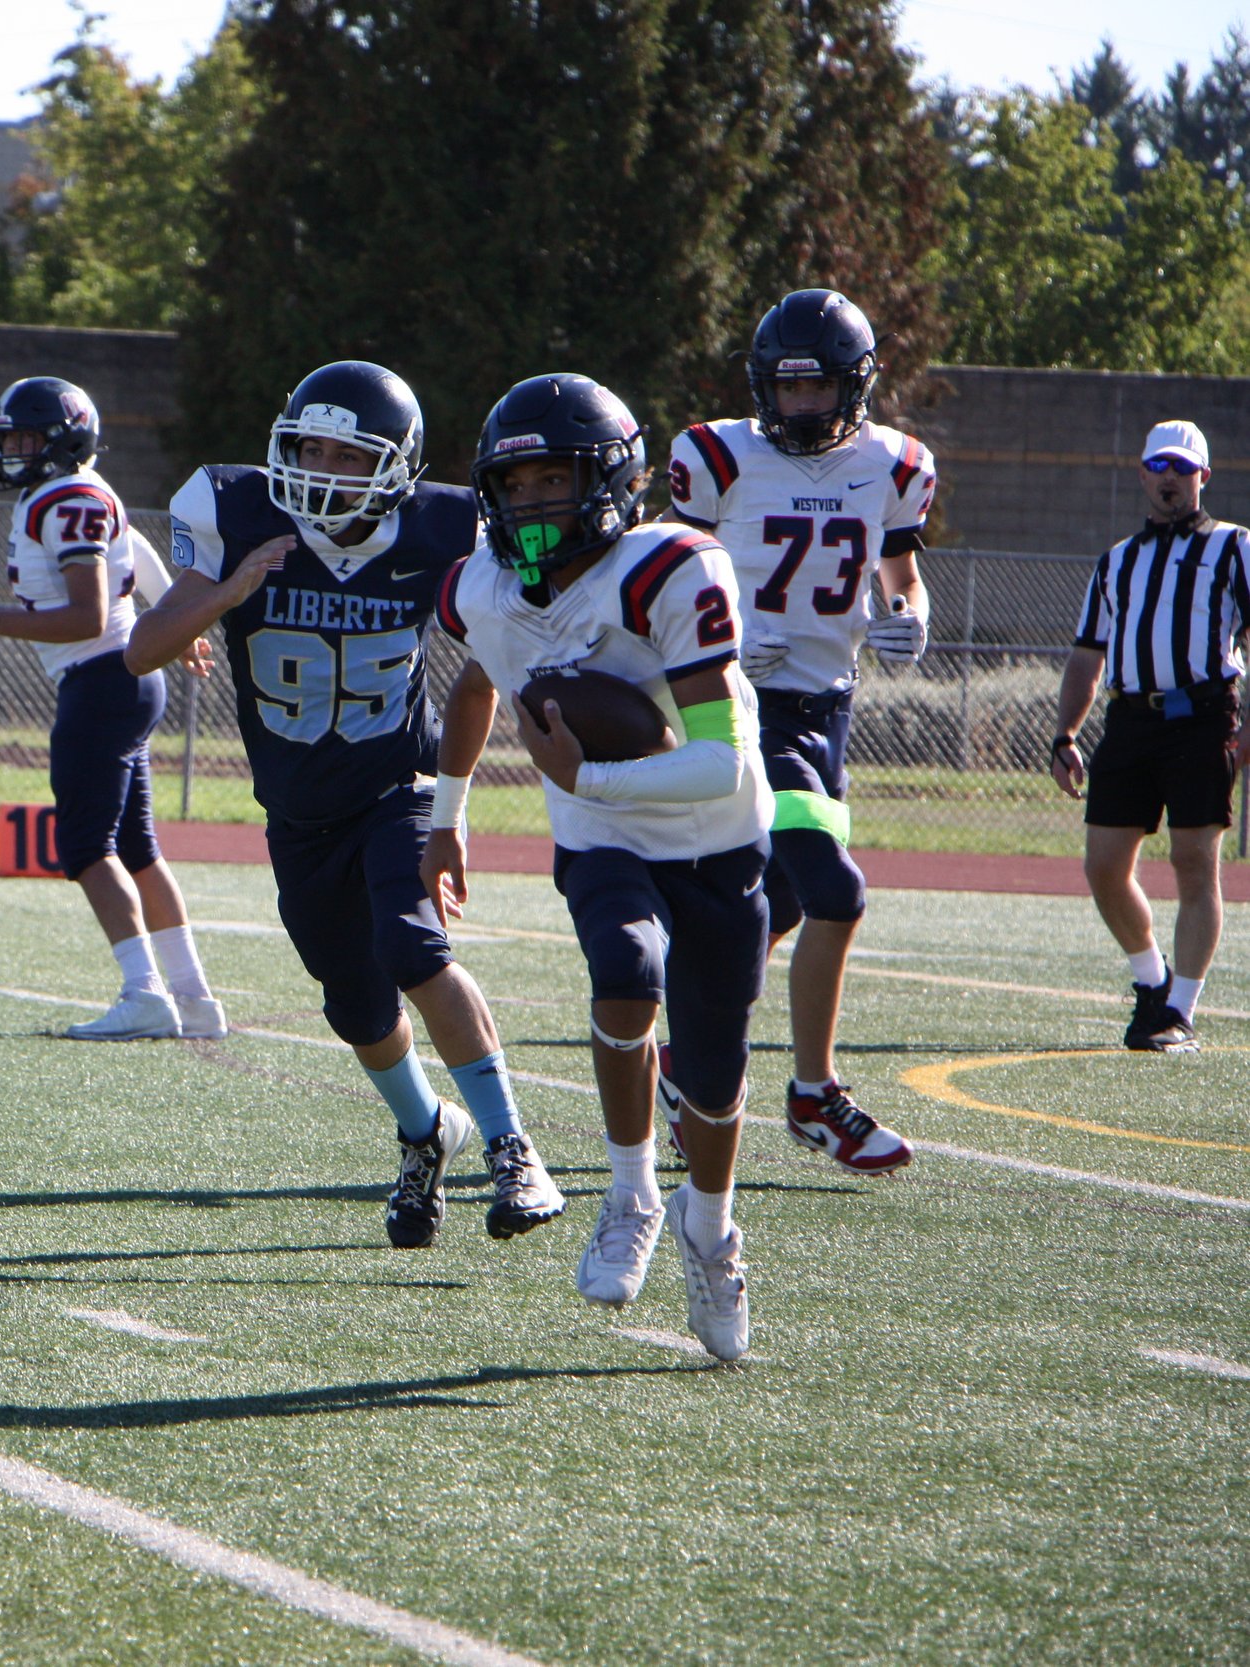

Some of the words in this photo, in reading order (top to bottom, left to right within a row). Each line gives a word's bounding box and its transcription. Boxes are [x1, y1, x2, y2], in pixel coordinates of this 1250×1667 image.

[782, 360, 815, 369] Riddell
[322, 405, 334, 417] X
[499, 436, 538, 450] Riddell
[56, 504, 109, 542] 75
[791, 496, 843, 512] WESTVIEW
[754, 515, 867, 616] 73
[263, 585, 415, 630] LIBERTY
[694, 584, 735, 648] 2
[246, 624, 421, 745] 95
